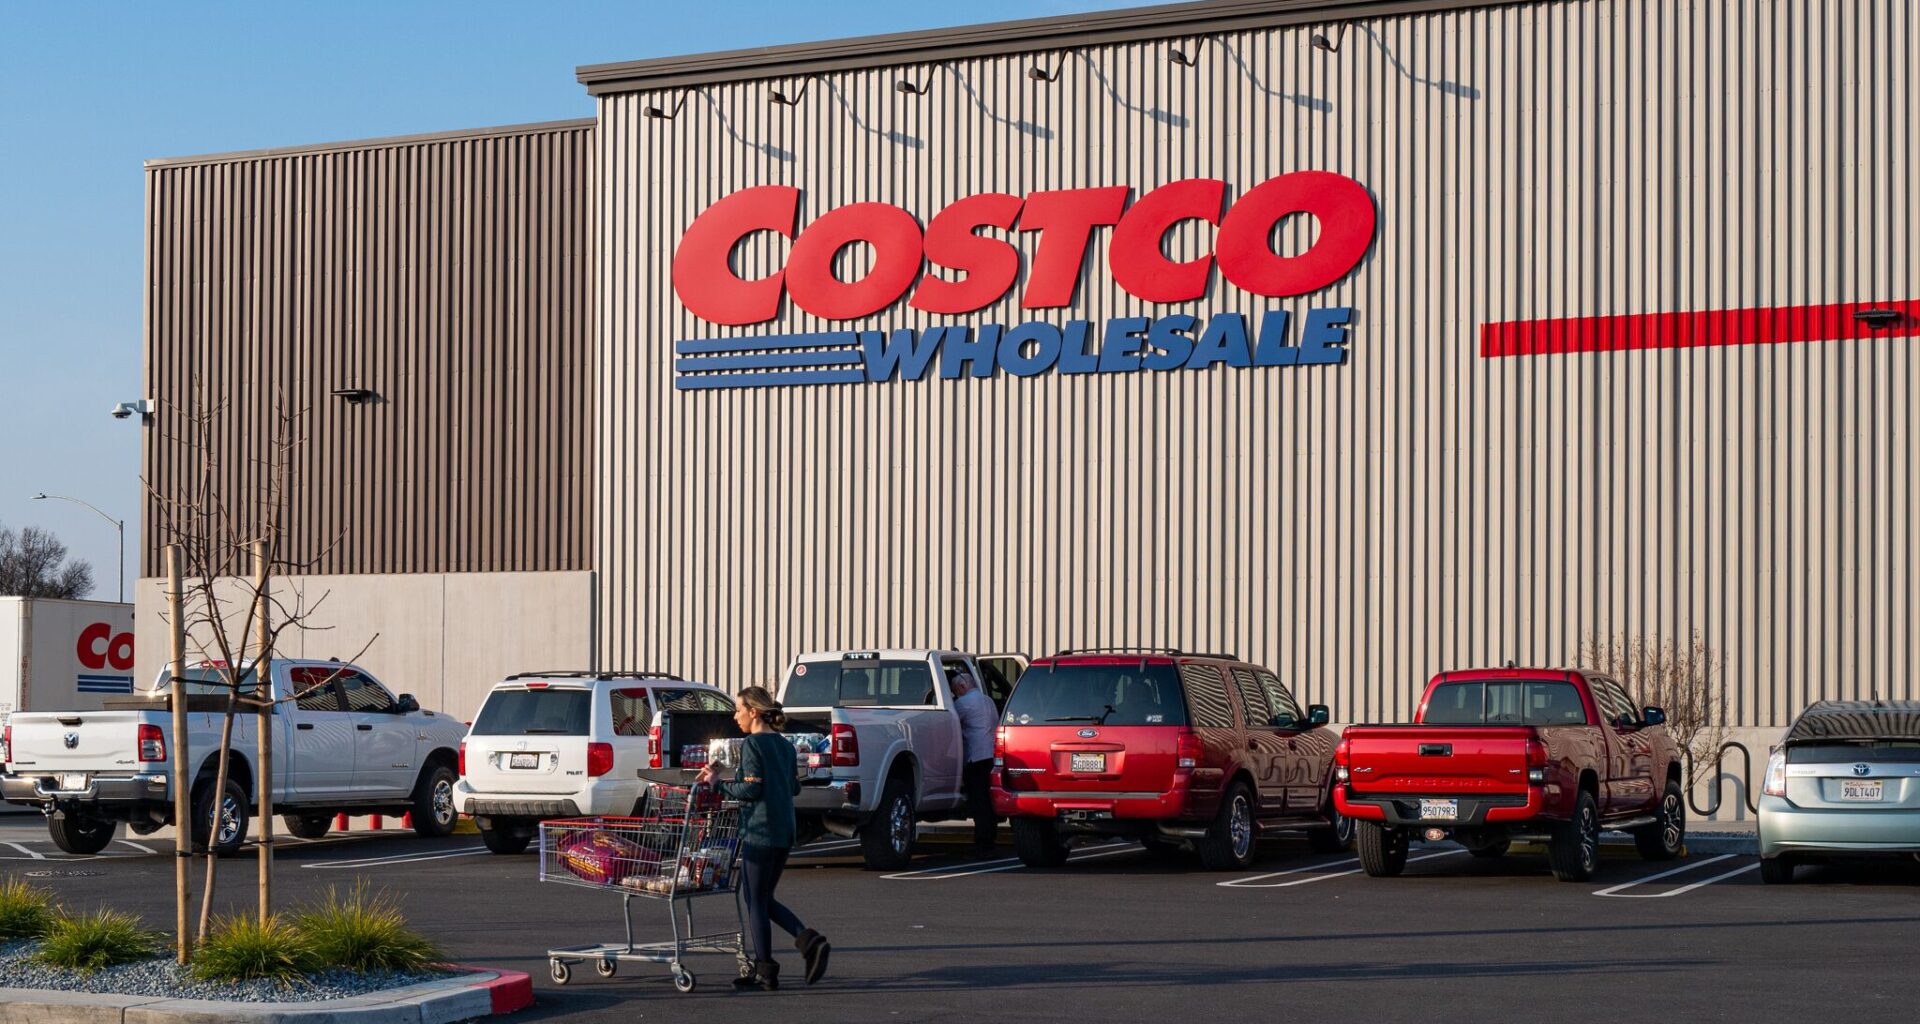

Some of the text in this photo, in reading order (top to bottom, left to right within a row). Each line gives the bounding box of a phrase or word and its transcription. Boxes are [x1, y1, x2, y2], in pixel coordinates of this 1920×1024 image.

[673, 170, 1377, 326] COSTCO
[862, 307, 1351, 382] WHOLESALE
[1422, 806, 1456, 816] 95079R3
[1844, 787, 1880, 797] 9DLT407
